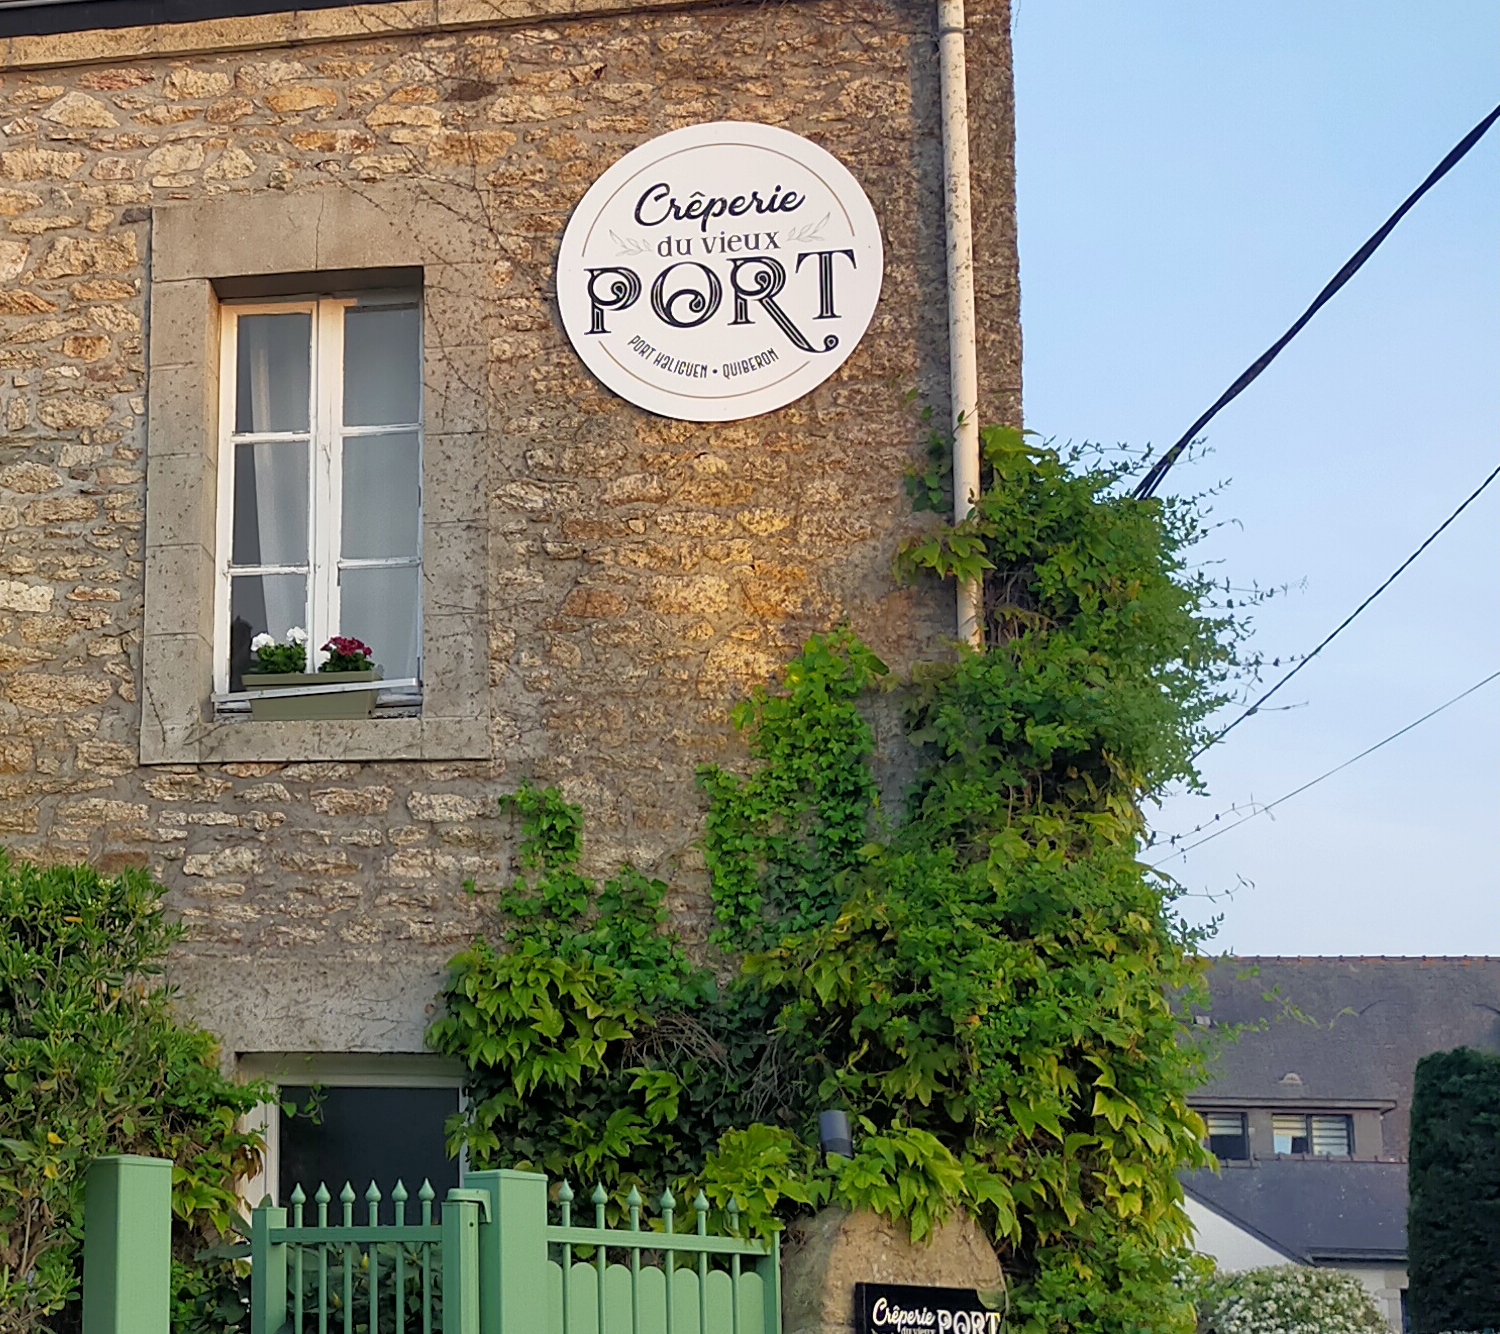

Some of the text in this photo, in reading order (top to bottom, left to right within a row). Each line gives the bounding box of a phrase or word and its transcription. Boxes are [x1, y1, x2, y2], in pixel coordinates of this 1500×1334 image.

[634, 182, 806, 232] Crêperie
[657, 230, 781, 257] du vieux
[584, 249, 857, 354] PORT
[628, 334, 657, 360] PORT
[722, 347, 780, 380] QUIBERON
[872, 1297, 936, 1333] Crêperie
